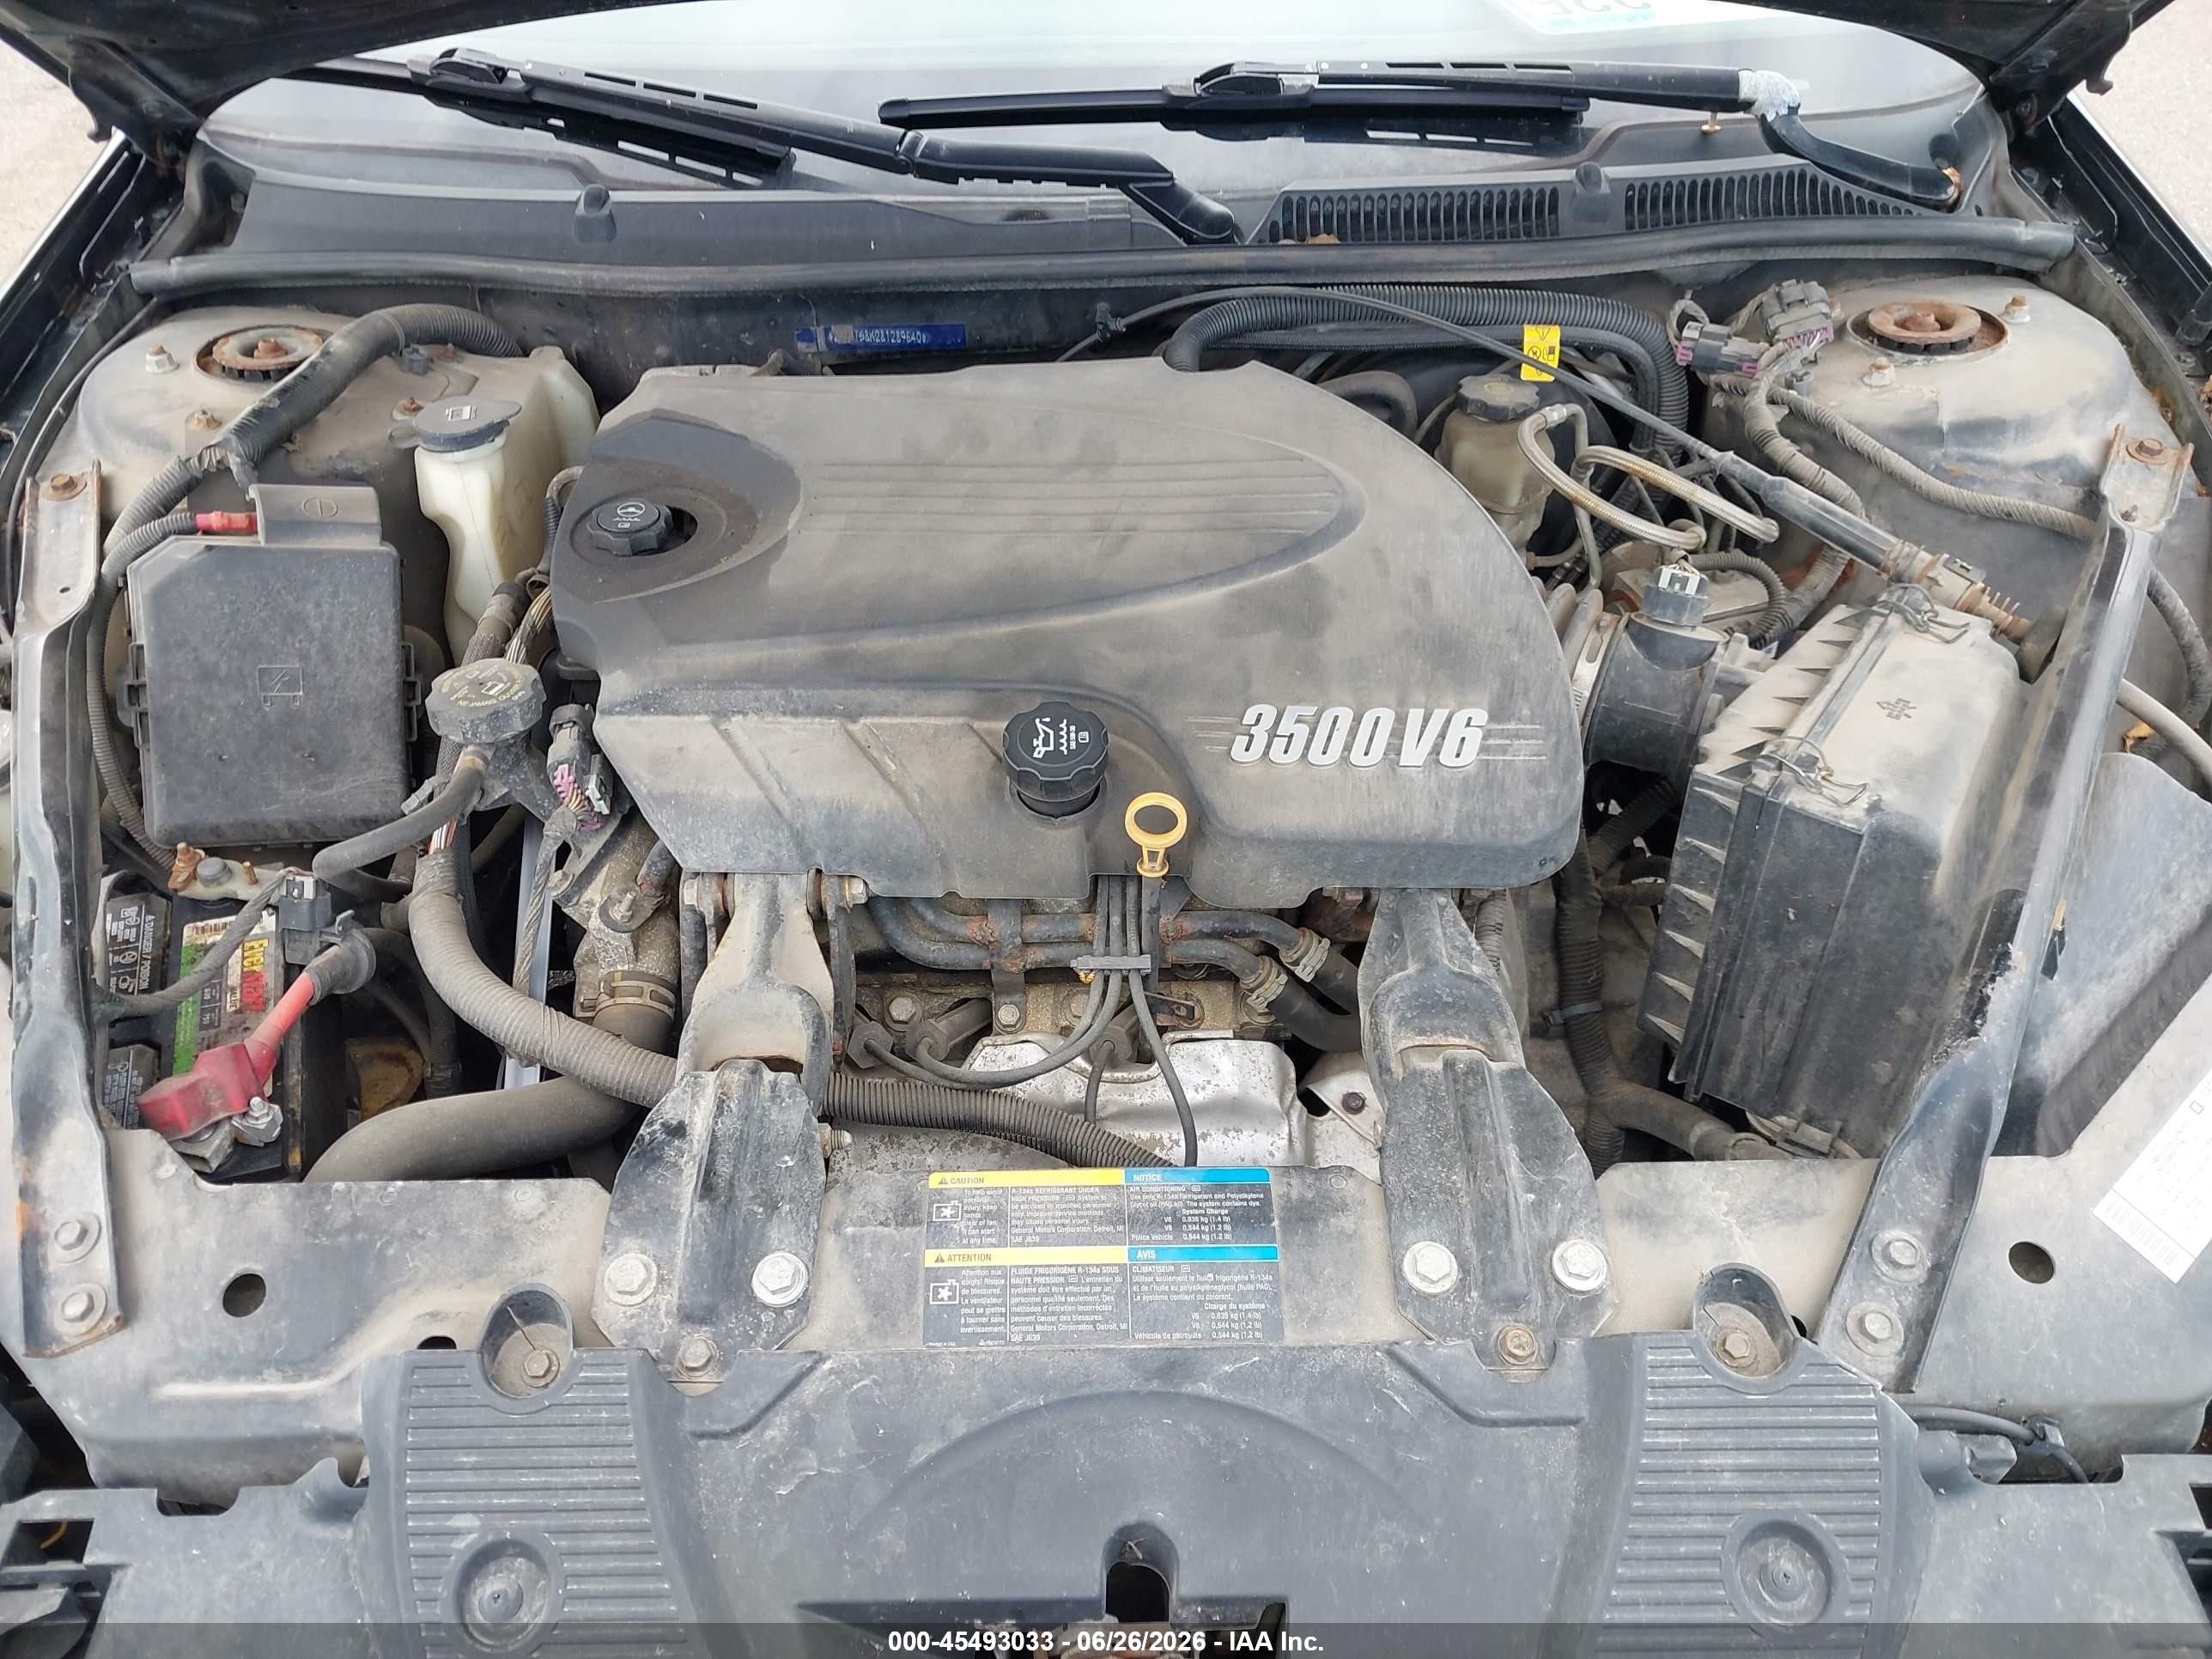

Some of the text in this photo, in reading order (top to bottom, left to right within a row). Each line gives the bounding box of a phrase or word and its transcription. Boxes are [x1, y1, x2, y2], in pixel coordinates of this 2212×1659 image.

[1231, 704, 1489, 768] 3500 V6
[948, 1254, 992, 1262] ATTENTION
[1137, 1250, 1156, 1259] AVIS
